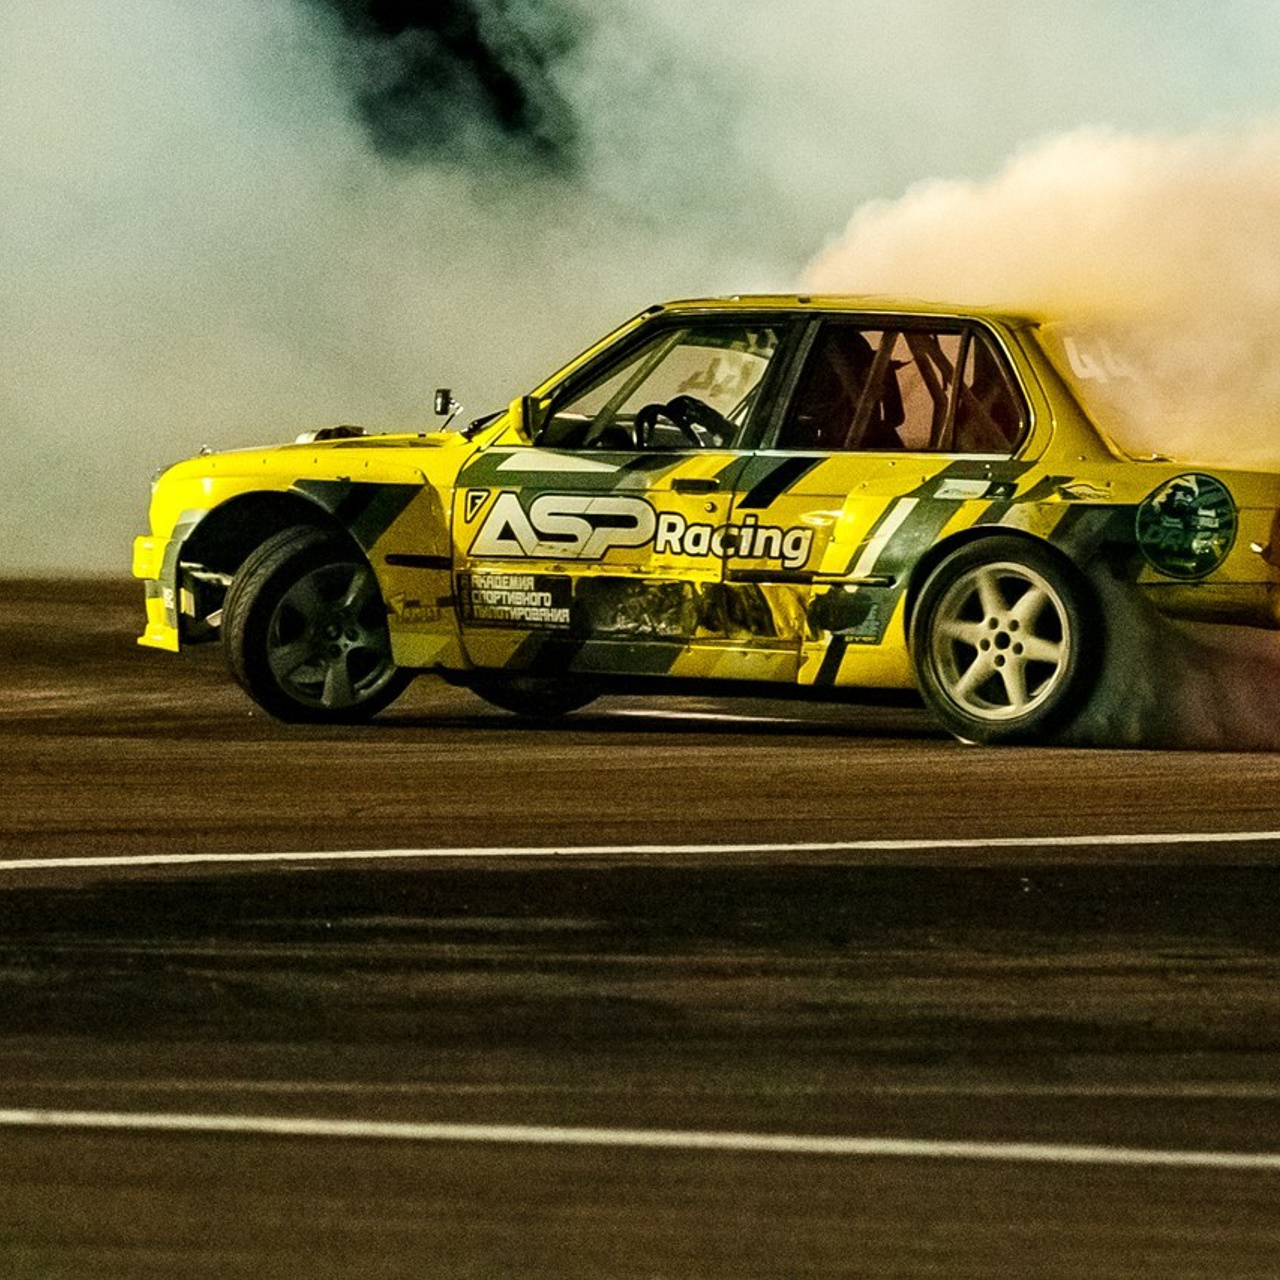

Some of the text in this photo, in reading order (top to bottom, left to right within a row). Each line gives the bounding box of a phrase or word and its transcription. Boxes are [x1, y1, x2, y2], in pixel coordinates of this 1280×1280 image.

[468, 491, 814, 568] ASP Racing
[472, 575, 534, 590] АКАДЕМИЯ
[472, 590, 552, 607] СПОРТИВНОГО
